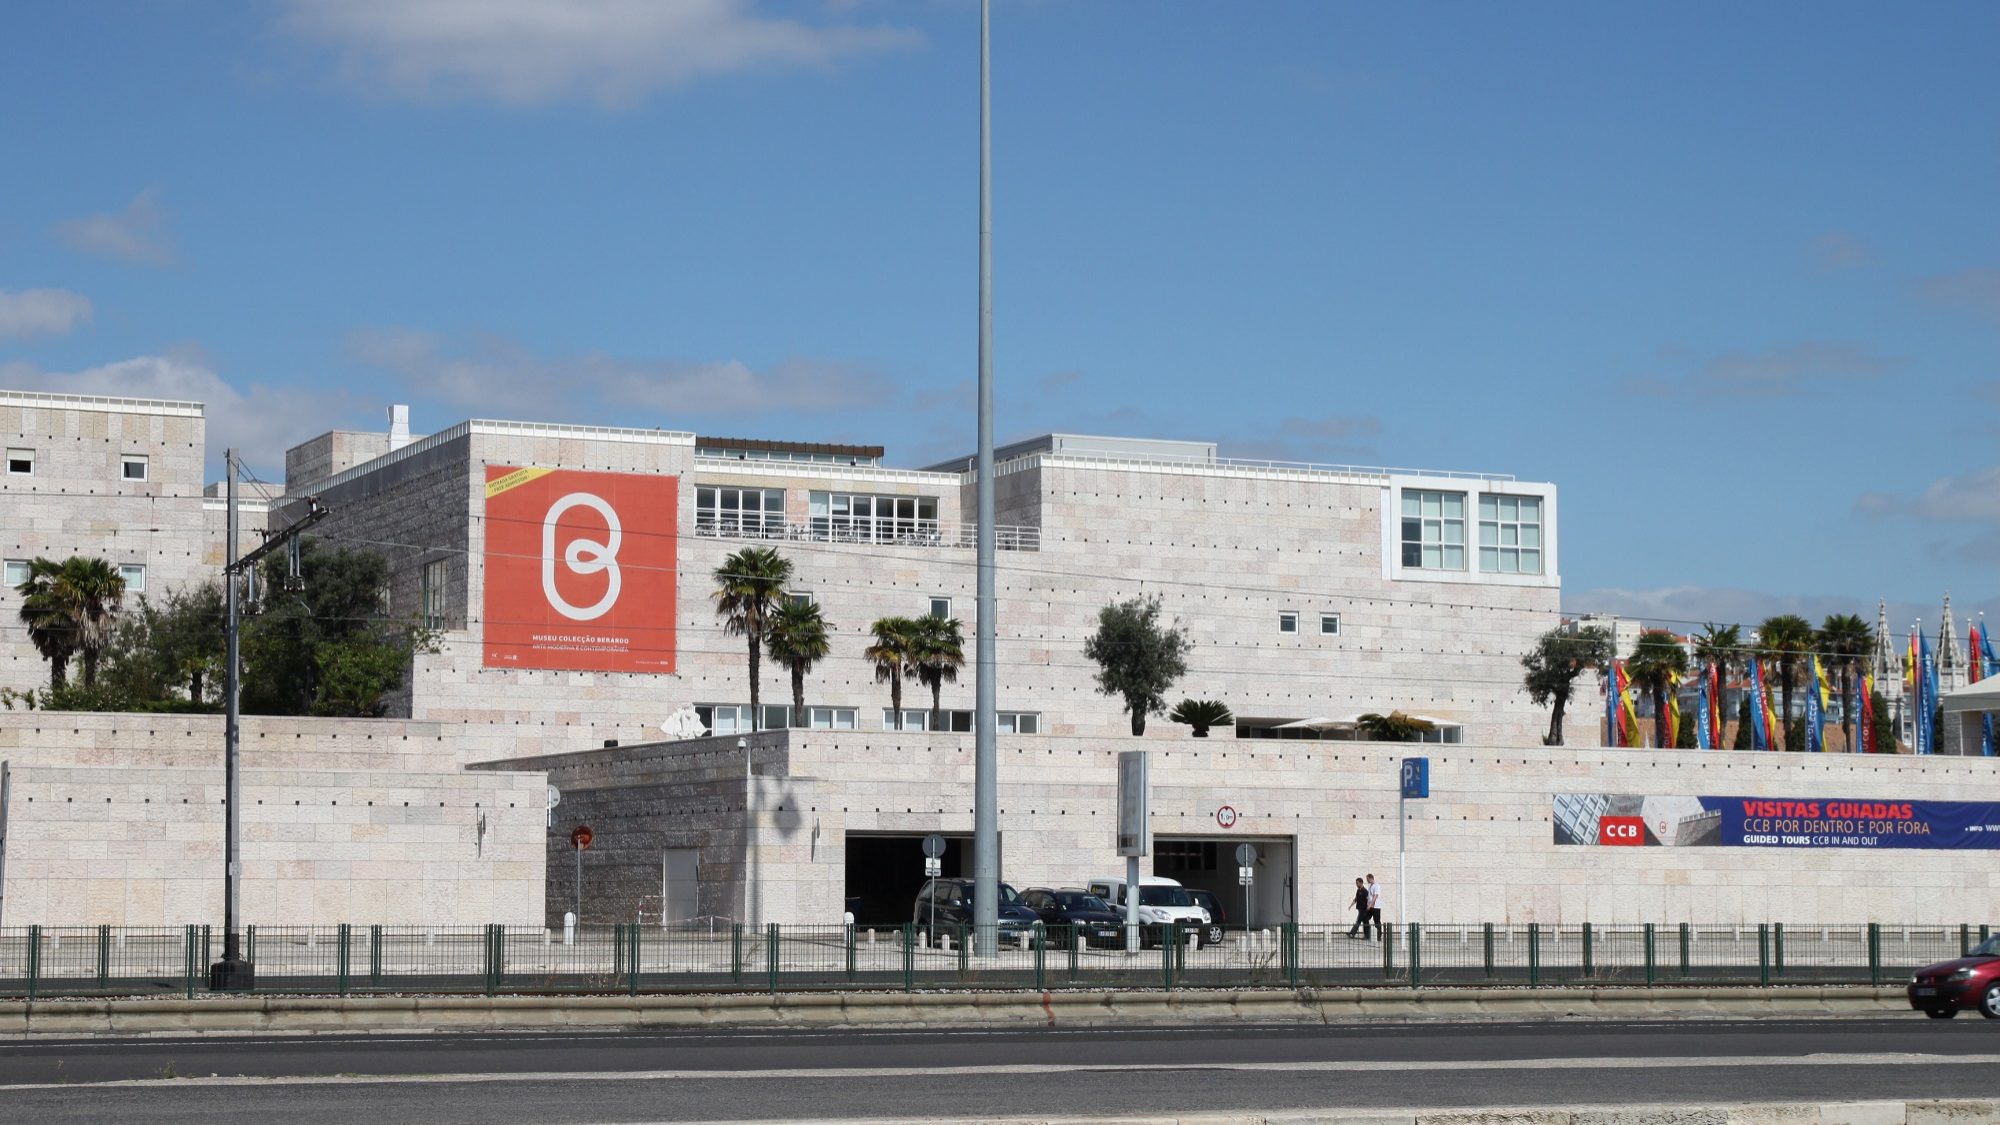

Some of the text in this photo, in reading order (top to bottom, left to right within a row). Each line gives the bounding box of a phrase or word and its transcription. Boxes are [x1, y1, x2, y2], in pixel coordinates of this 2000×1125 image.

[558, 634, 596, 644] COLECÇÃO
[1743, 801, 1913, 819] VISITAS GUIADAS
[1606, 824, 1637, 837] CCB
[1743, 819, 1930, 834] CCB POR DENTRO E POR FORA
[1985, 824, 2000, 832] WW
[1743, 835, 1878, 845] GUIDED TOURS CCB IN AND OUT
